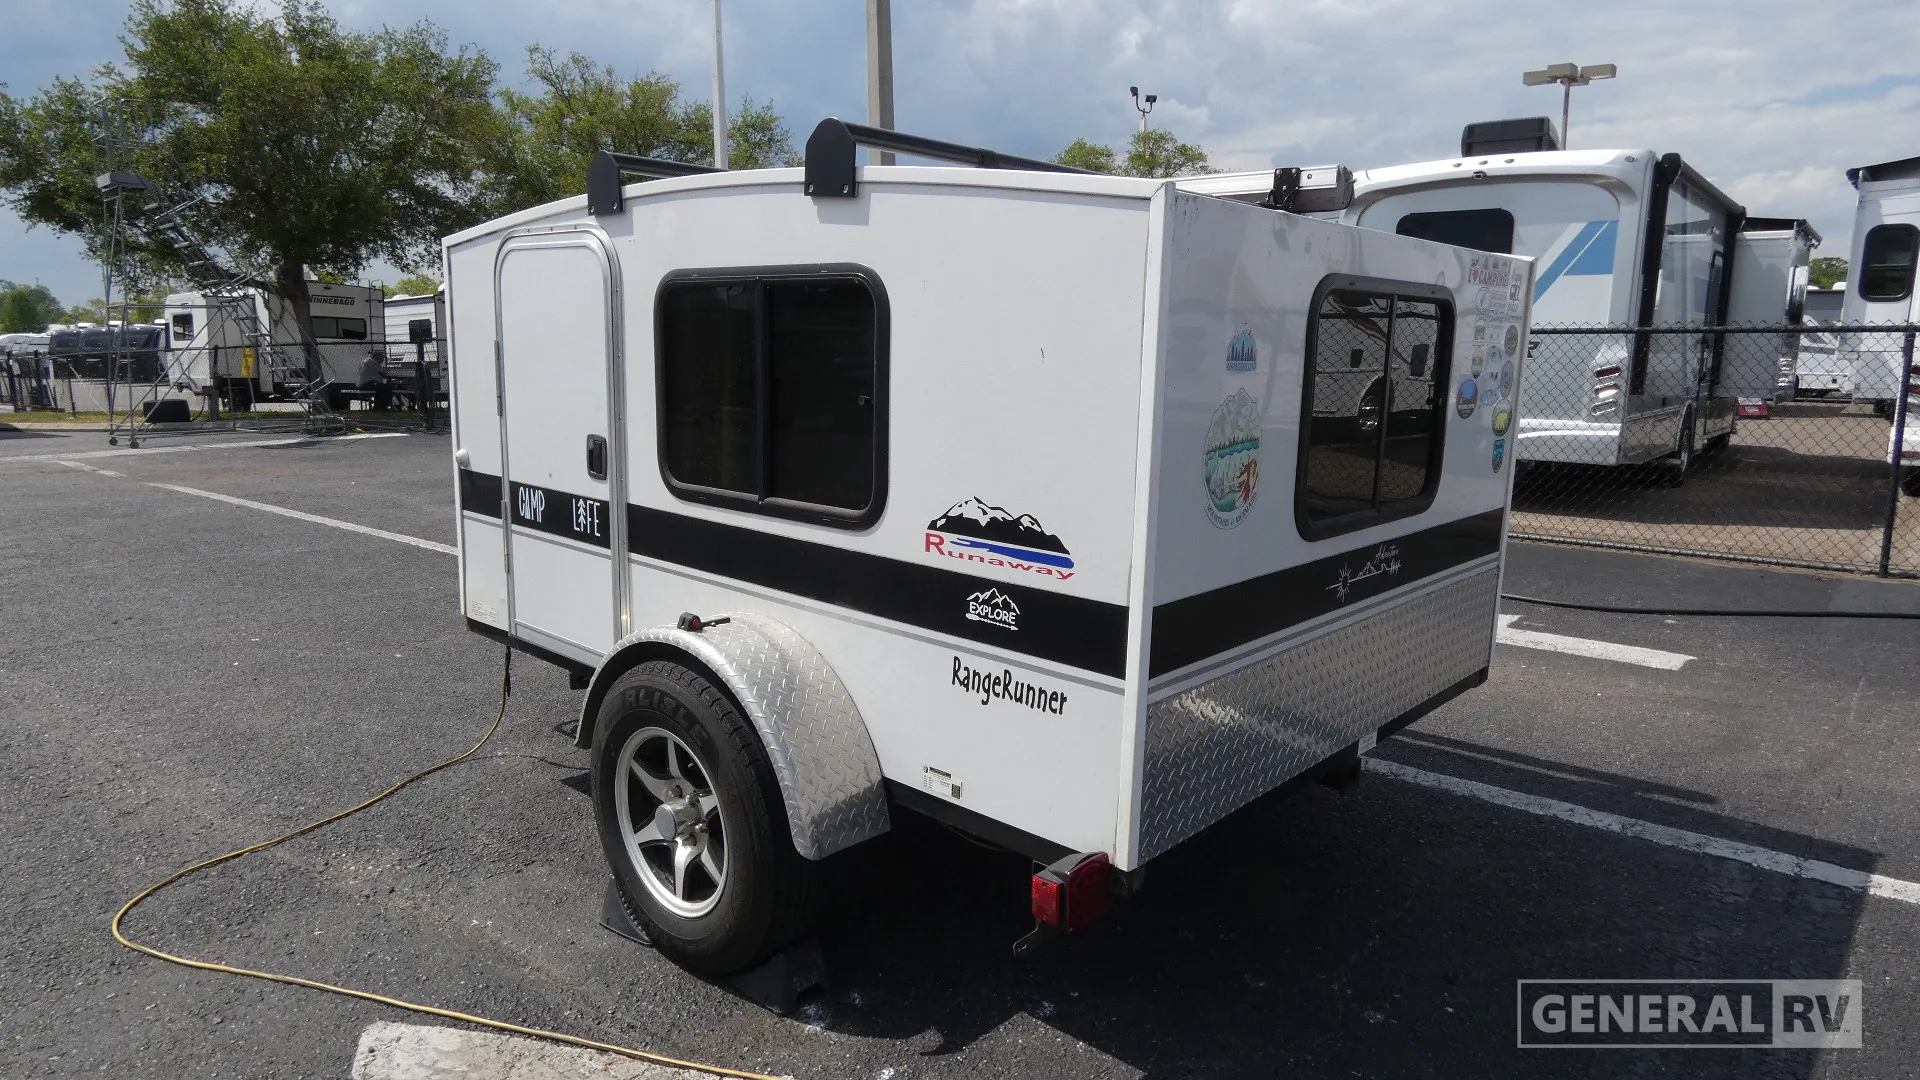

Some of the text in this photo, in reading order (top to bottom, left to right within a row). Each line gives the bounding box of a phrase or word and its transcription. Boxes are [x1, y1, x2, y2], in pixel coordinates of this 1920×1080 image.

[518, 486, 545, 523] CAMP
[924, 532, 1076, 580] Runaway
[969, 602, 1016, 625] EXPLORE
[951, 656, 1068, 716] RangeRunner
